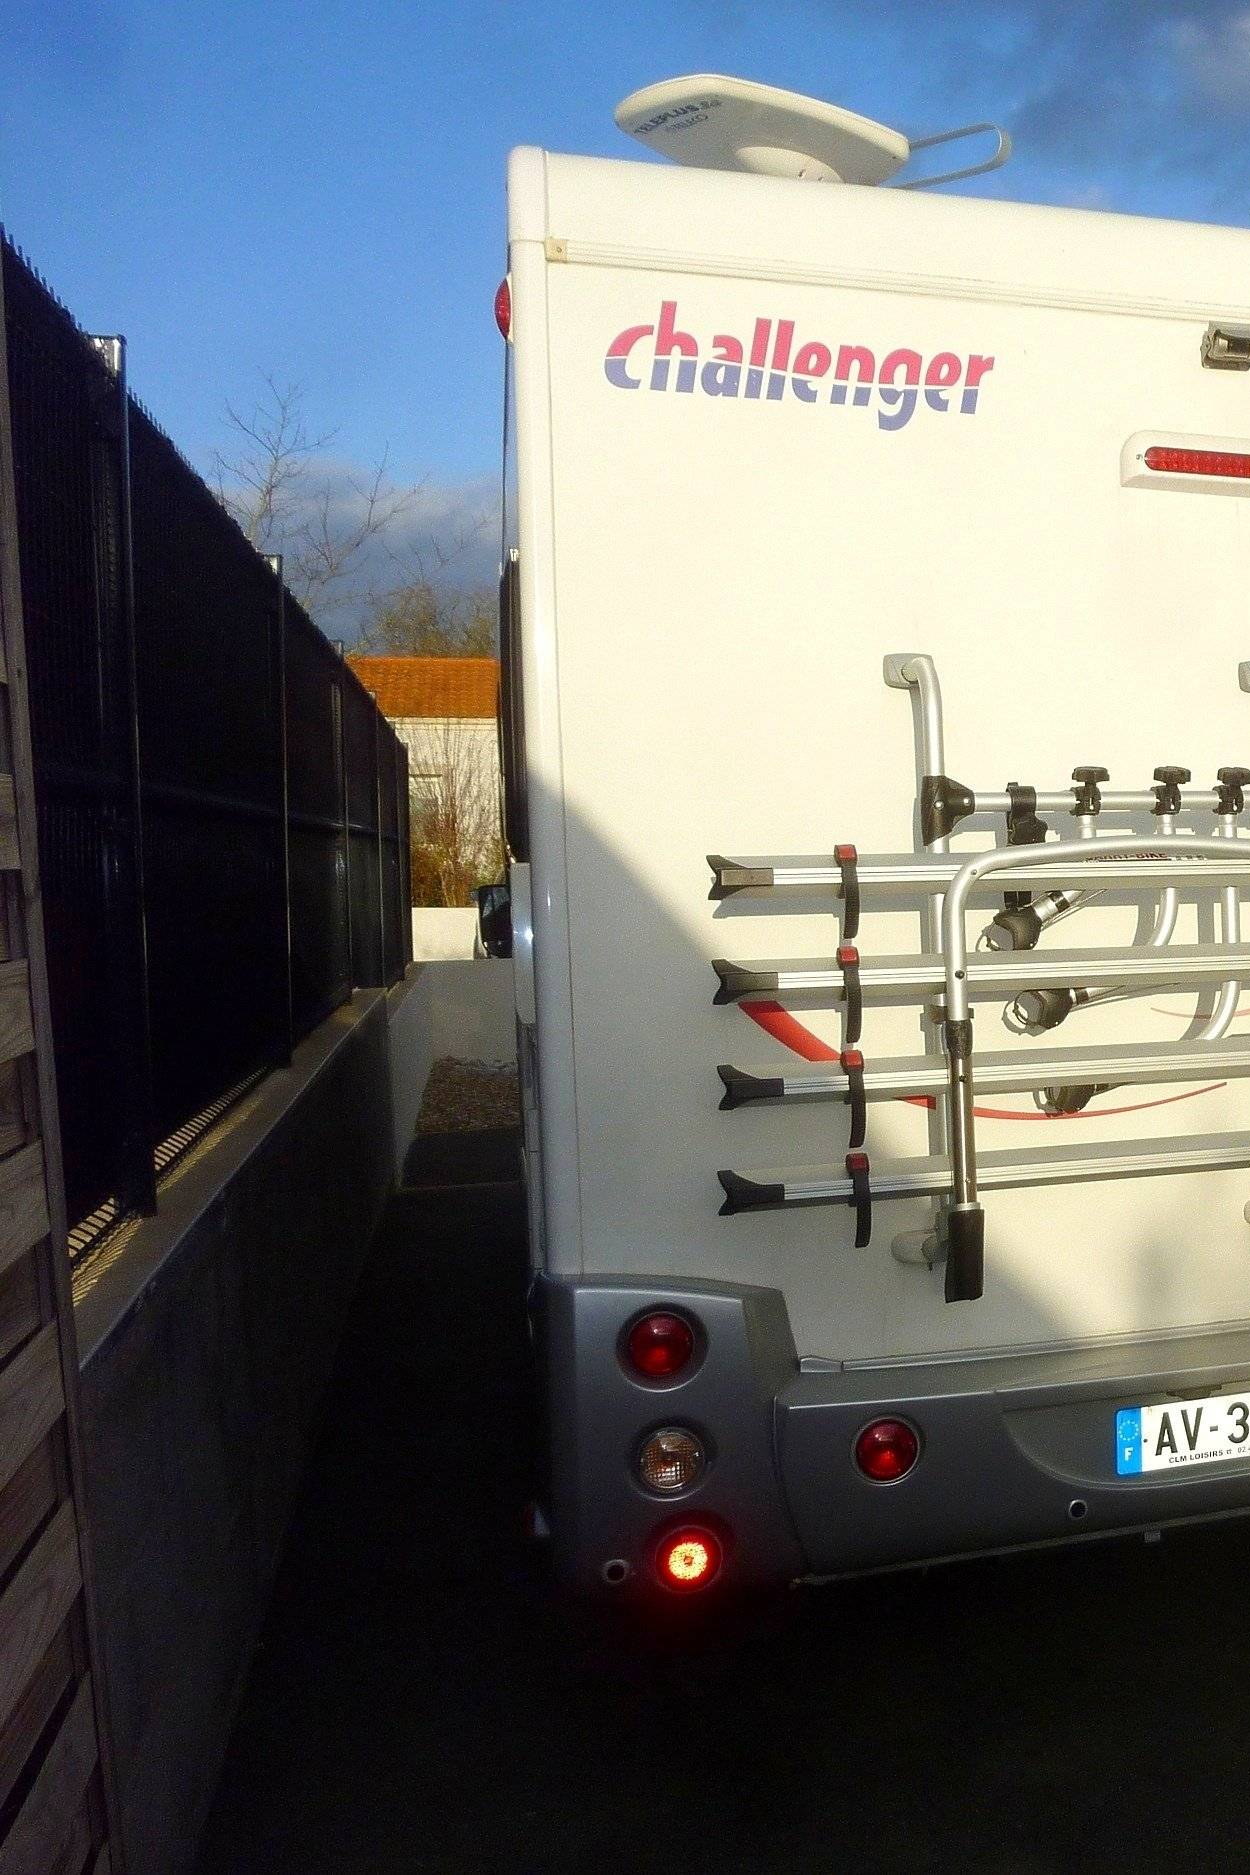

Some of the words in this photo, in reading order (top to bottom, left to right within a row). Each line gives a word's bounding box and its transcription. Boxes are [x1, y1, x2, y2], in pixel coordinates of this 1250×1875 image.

[604, 301, 995, 431] challenger
[1124, 1447, 1134, 1461] F
[1168, 1455, 1188, 1464] CLM
[1189, 1449, 1224, 1461] LOISIRS
